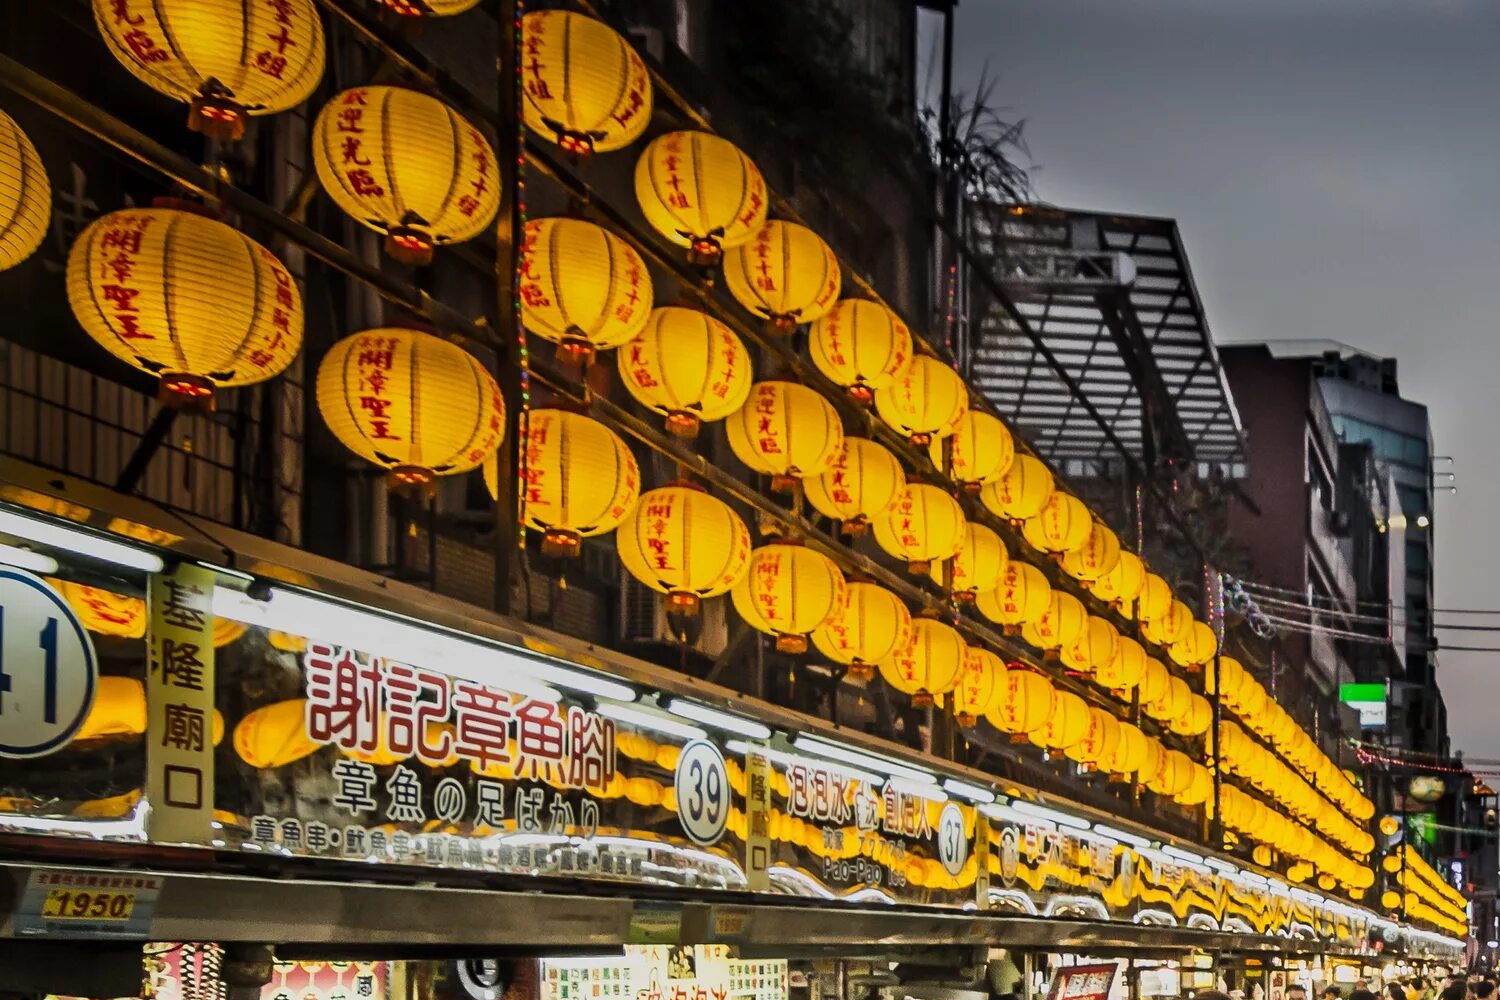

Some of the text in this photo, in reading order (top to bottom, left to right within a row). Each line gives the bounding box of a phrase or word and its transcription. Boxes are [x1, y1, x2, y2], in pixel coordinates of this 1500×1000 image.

[161, 580, 206, 810] 基隆廟口
[306, 643, 618, 794] 謝記章魚腳
[333, 760, 604, 841] 章魚の足ばかり
[688, 757, 722, 826] 39
[786, 762, 851, 825] 泡泡冰
[944, 818, 962, 857] 37
[55, 890, 128, 918] 1950
